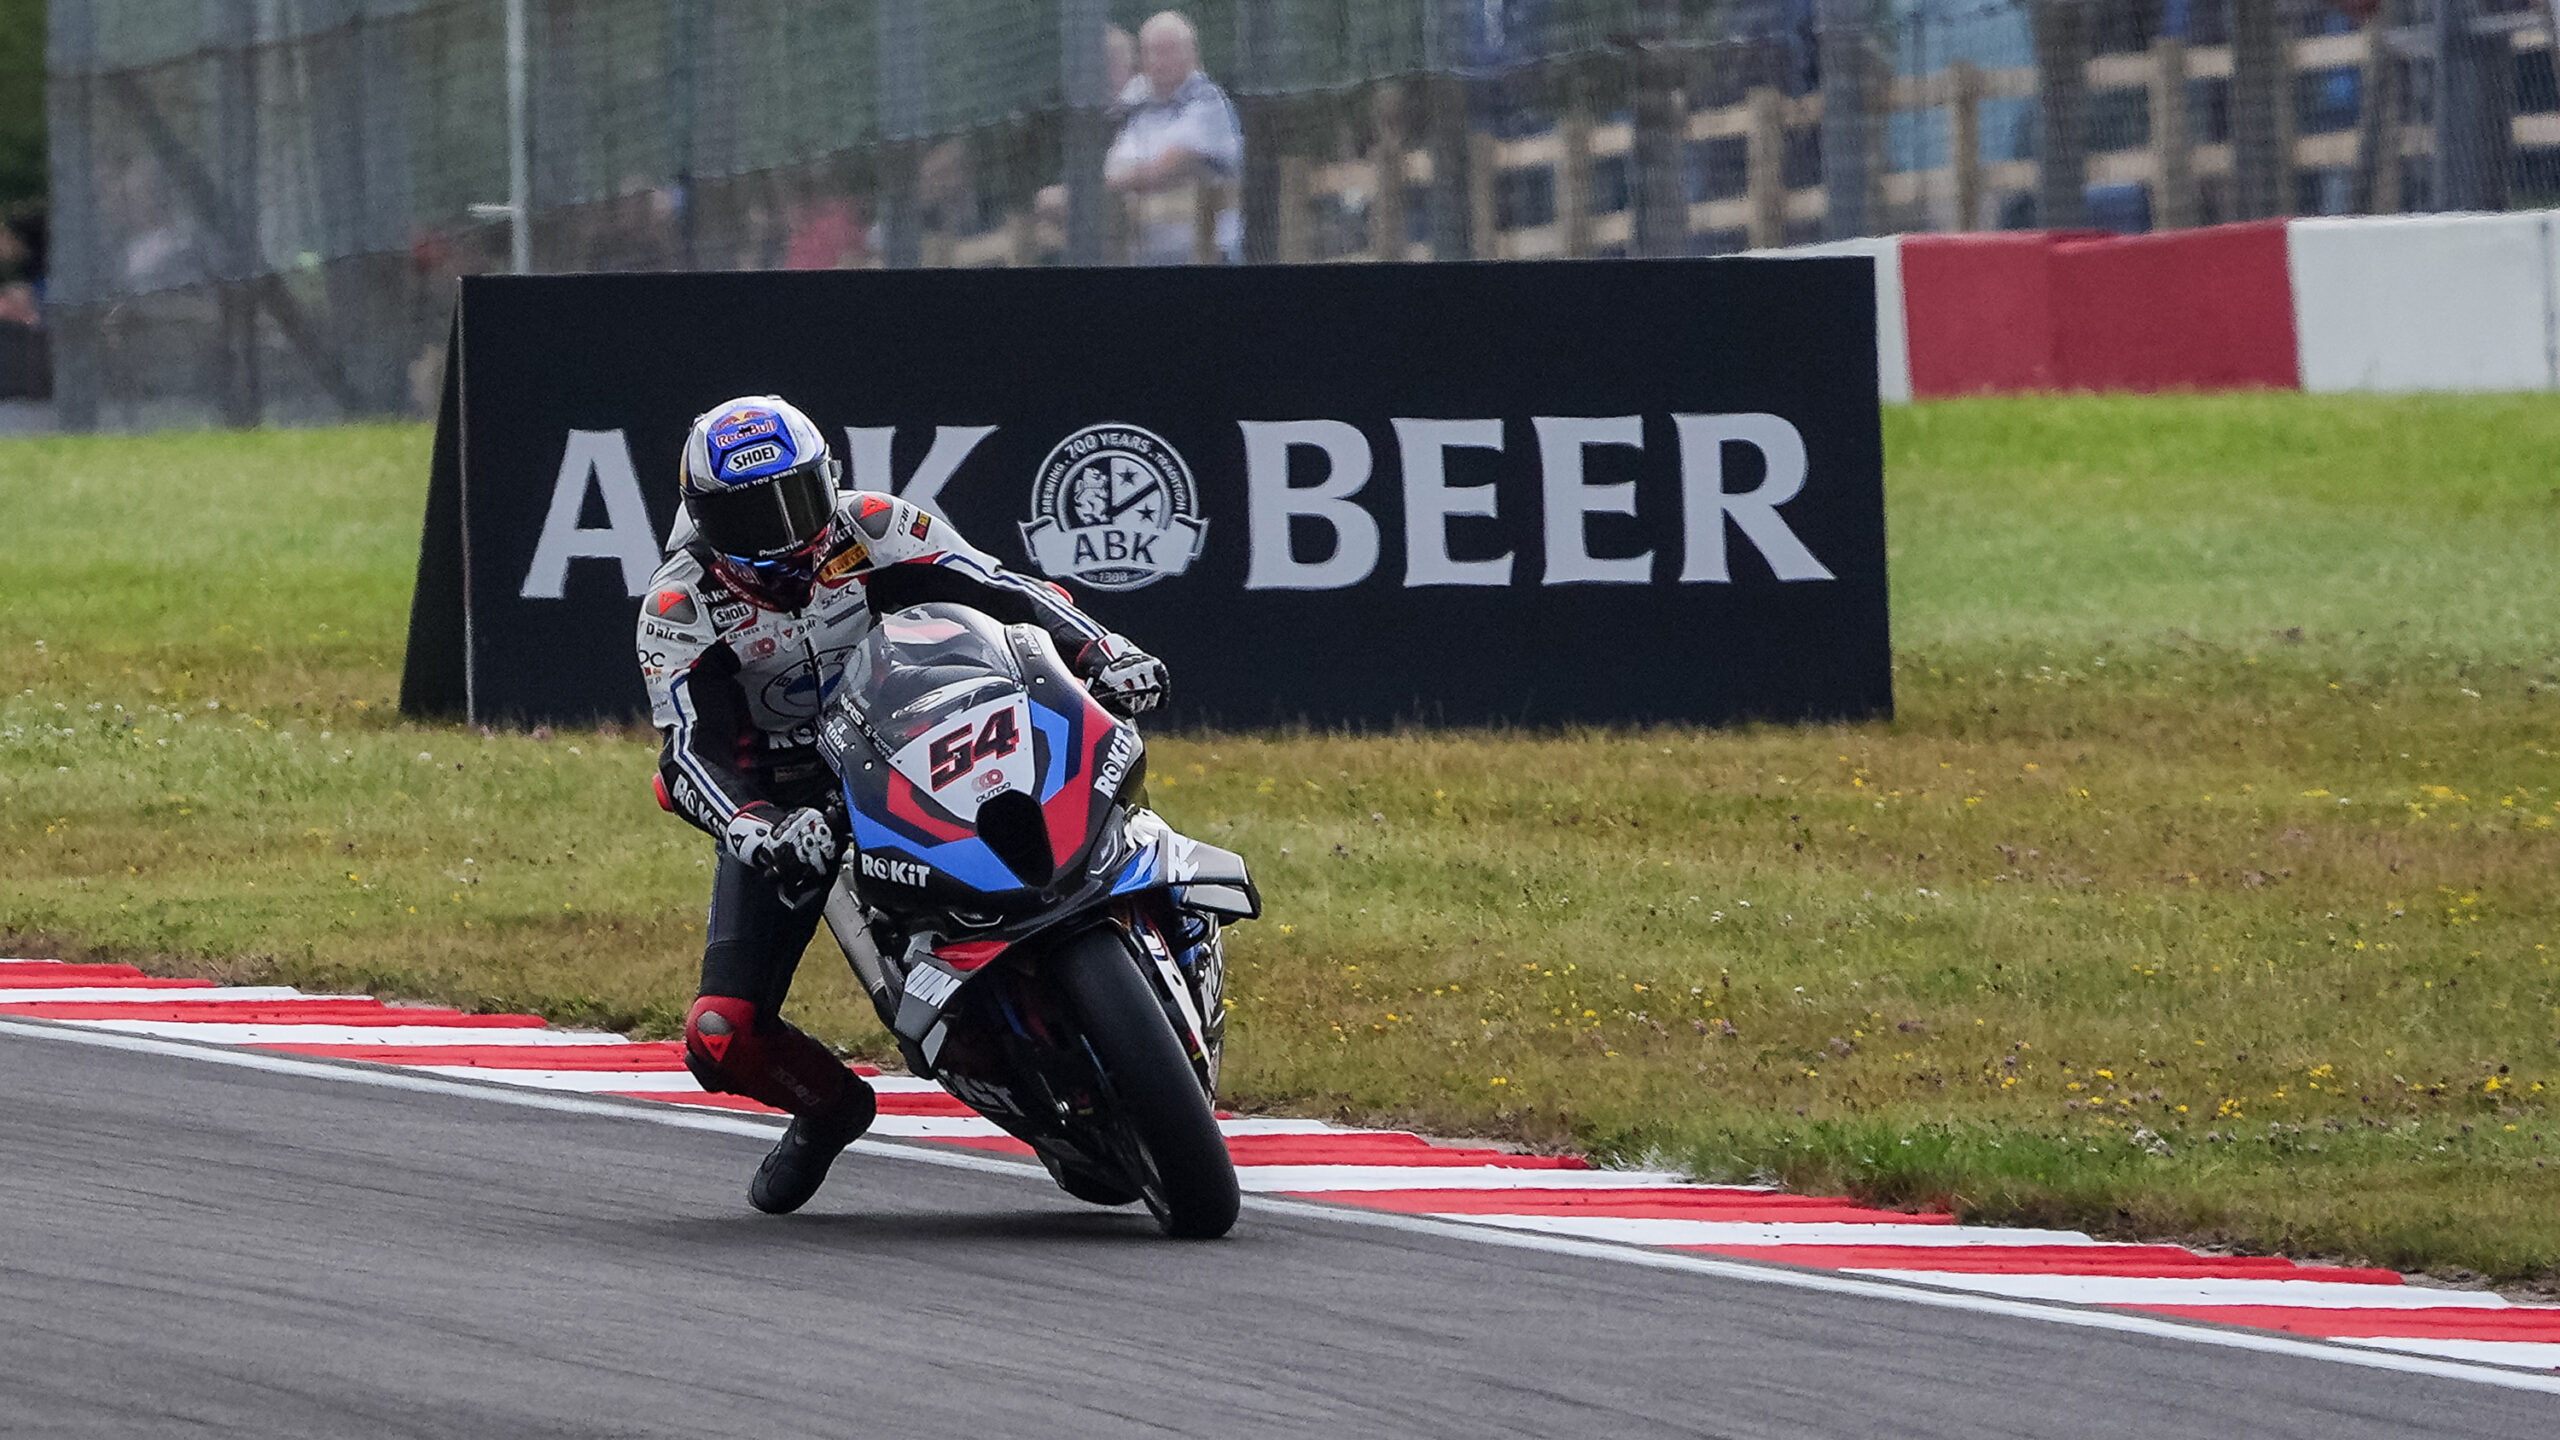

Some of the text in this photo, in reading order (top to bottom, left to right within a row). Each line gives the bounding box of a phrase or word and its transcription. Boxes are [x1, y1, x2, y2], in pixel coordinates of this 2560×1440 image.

[716, 418, 778, 449] Red Bull
[732, 446, 776, 470] SHOEI
[1041, 432, 1188, 513] BREWING 700 YEARS TRADITION
[752, 476, 770, 487] YOU
[519, 412, 1837, 599] AK BEER
[1073, 529, 1160, 565] ABK
[716, 604, 750, 623] SHOEI
[929, 706, 1019, 792] 54
[975, 781, 1012, 803] OUTDO
